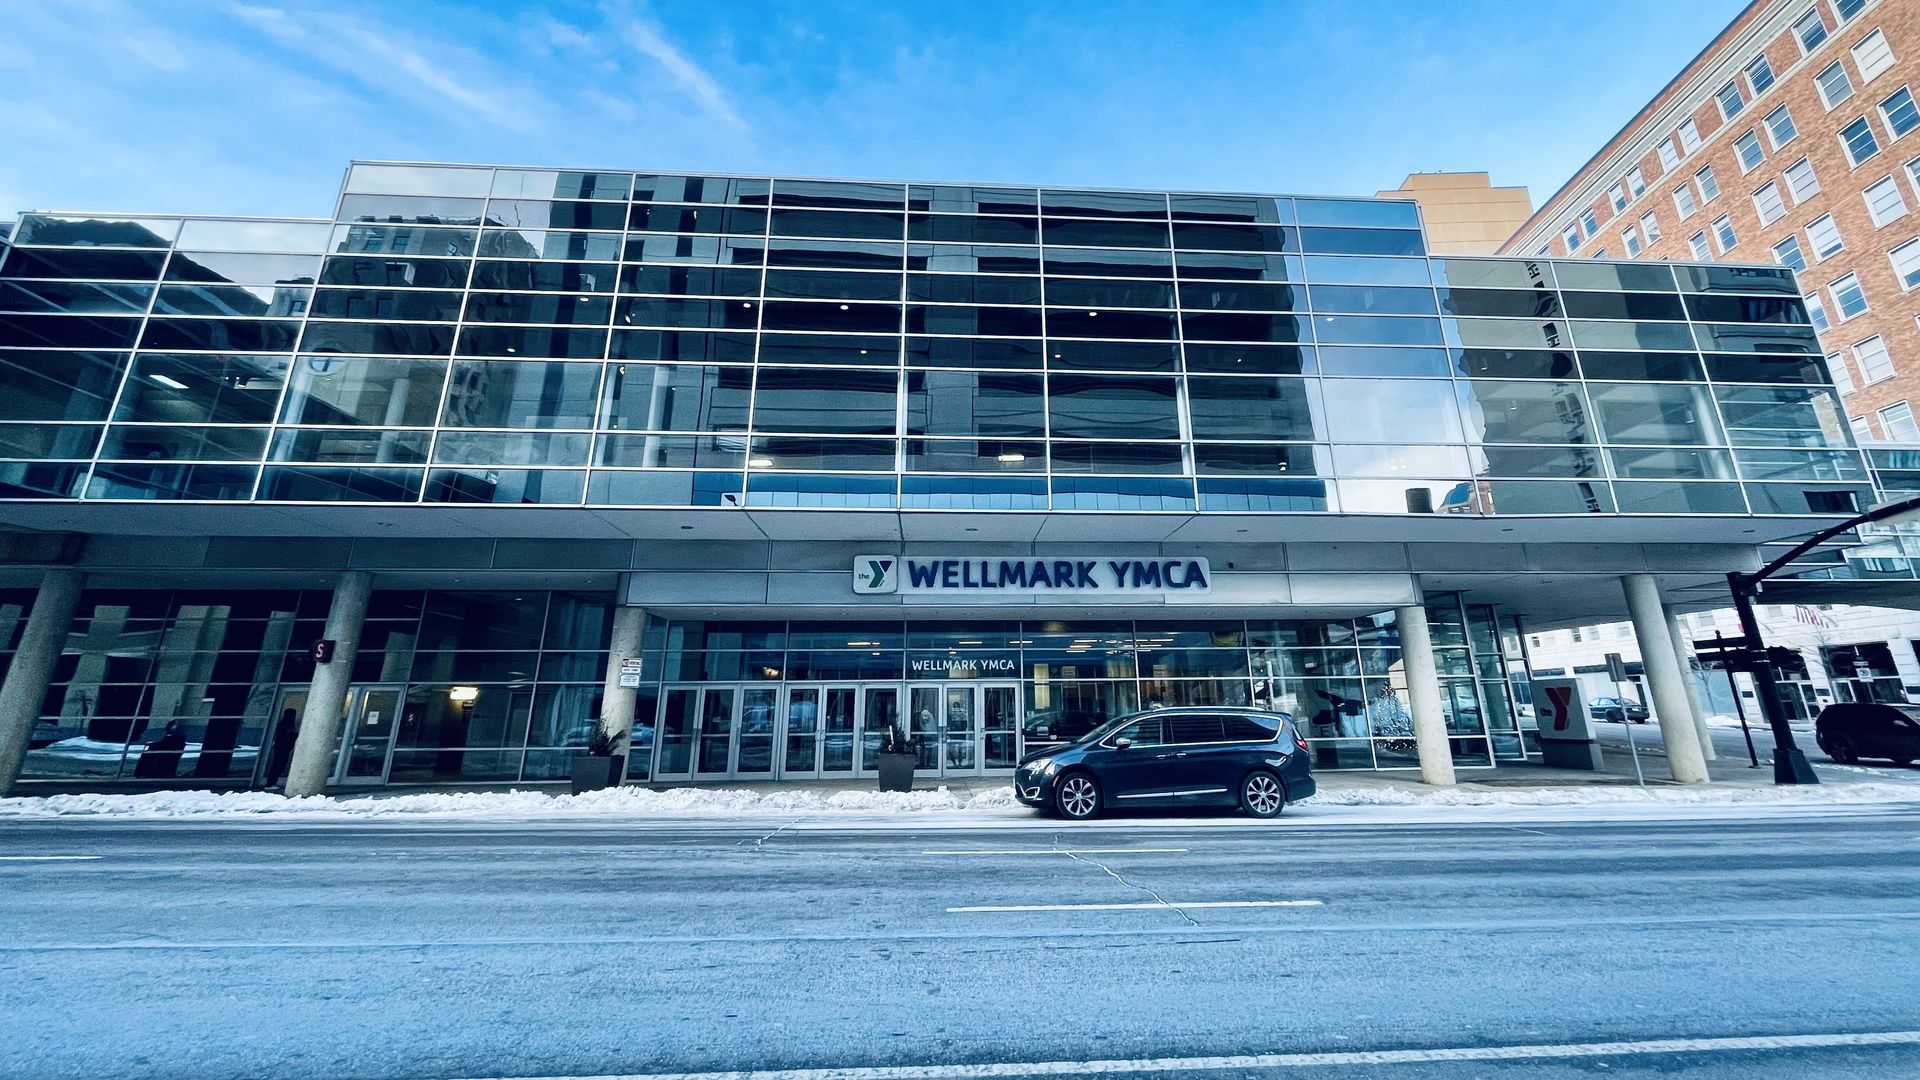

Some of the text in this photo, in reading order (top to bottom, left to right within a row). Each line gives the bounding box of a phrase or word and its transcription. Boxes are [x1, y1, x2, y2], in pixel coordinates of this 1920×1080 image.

[908, 560, 1208, 588] WELLMARK YMCA
[315, 643, 325, 658] S
[912, 659, 1015, 671] WELLMARK YMCA
[1540, 706, 1553, 717] the
